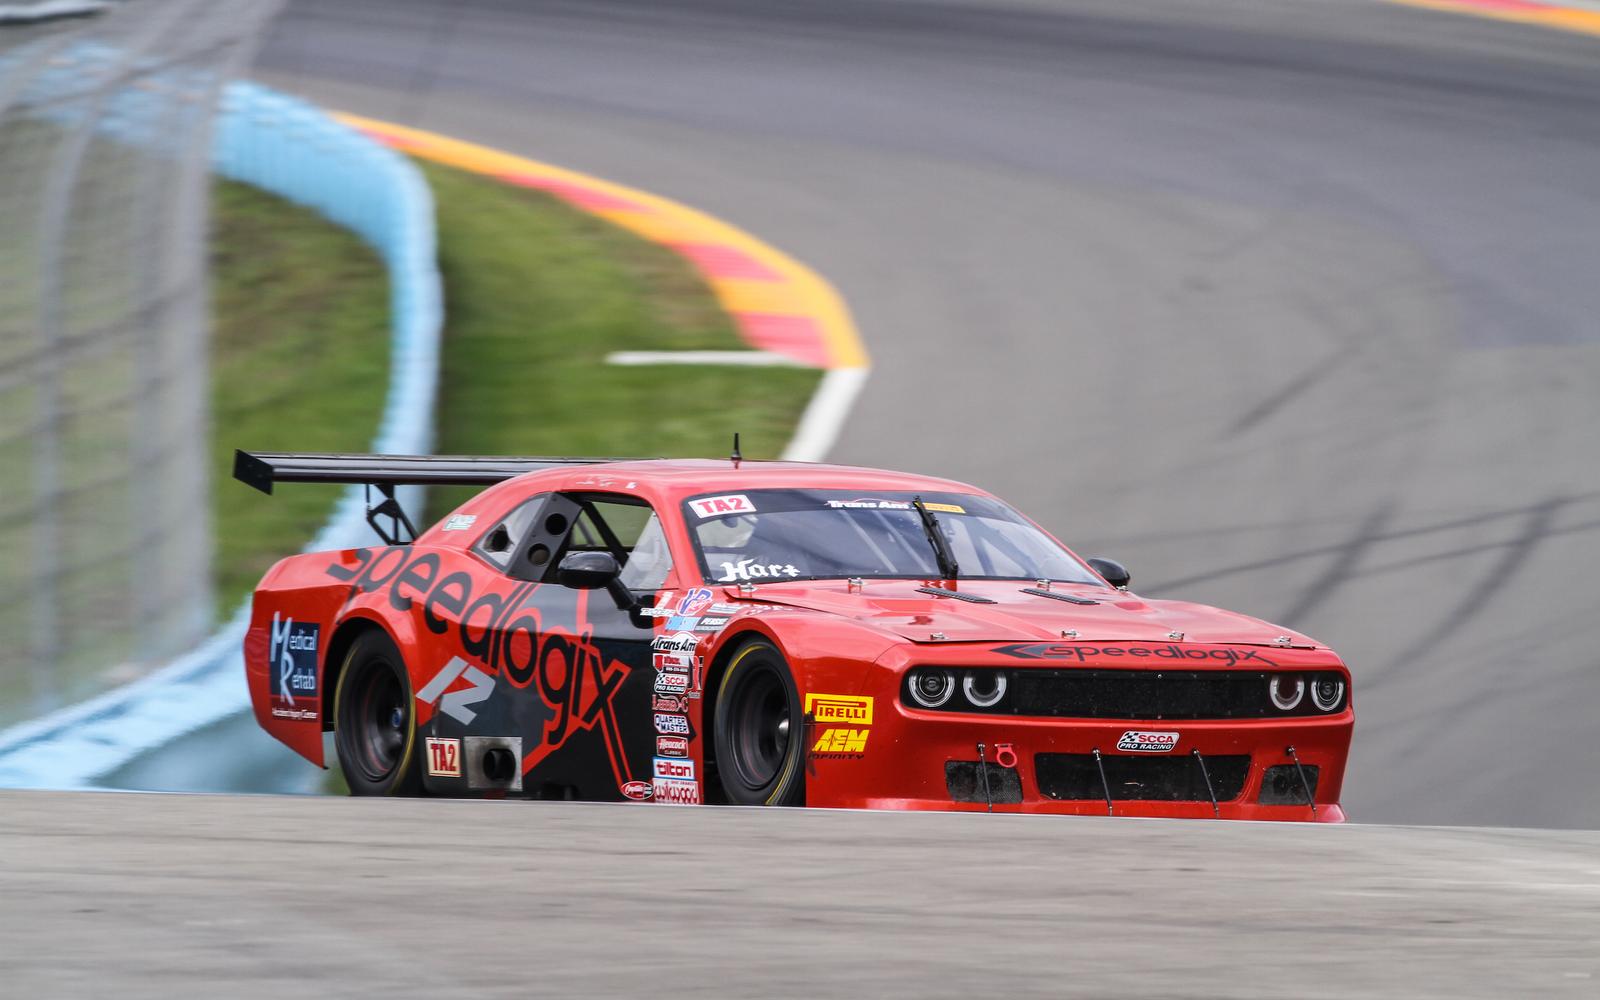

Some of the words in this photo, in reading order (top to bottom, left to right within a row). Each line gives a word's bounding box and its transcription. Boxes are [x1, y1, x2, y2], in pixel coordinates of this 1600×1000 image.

[698, 498, 747, 513] TA2
[824, 500, 877, 508] Trans
[654, 636, 680, 650] Trans
[680, 638, 695, 651] Am
[665, 676, 685, 685] SCCA
[811, 698, 867, 719] PIRELLI
[661, 724, 688, 732] MASTER
[812, 728, 870, 752] AEM
[1138, 734, 1174, 743] SCCA
[430, 742, 457, 772] TA2
[656, 762, 691, 777] tilton
